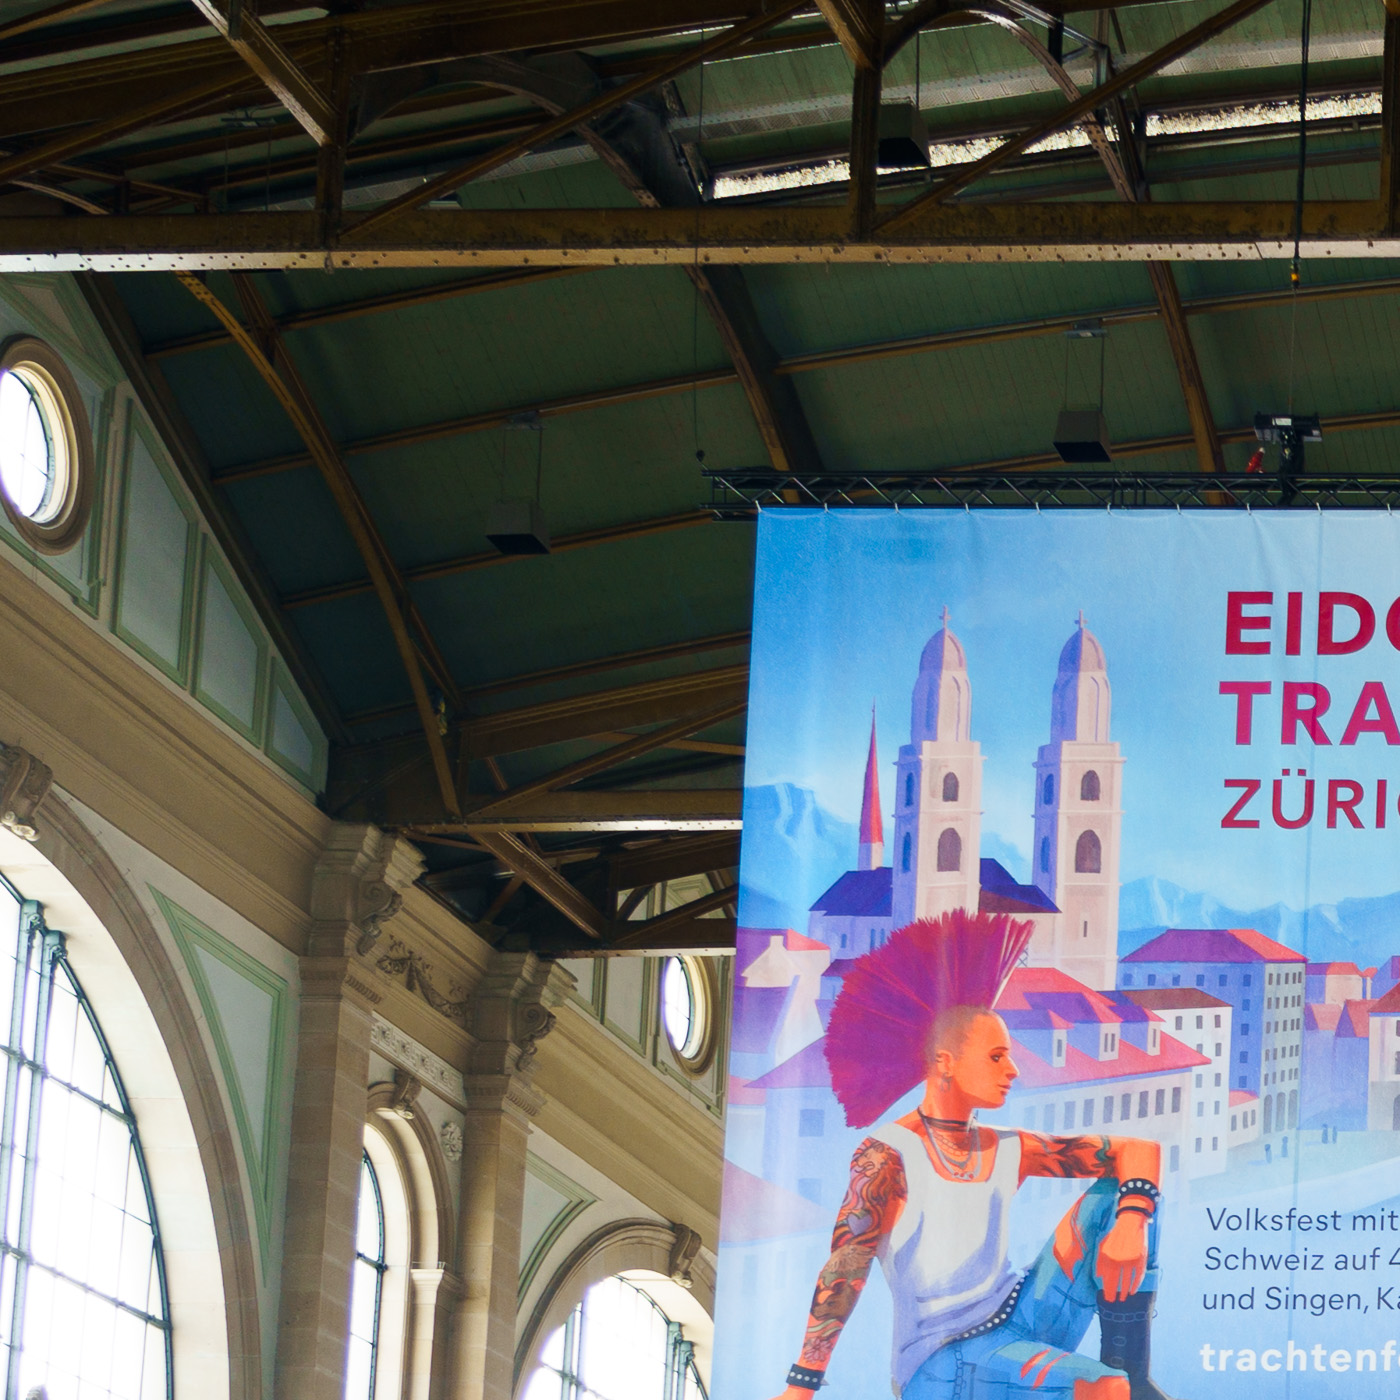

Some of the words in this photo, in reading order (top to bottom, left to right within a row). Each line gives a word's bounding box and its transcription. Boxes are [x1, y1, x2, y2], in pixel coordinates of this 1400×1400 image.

[1207, 1208, 1341, 1231] Volksfest
[1353, 1208, 1398, 1231] mit
[1205, 1247, 1323, 1270] Schweiz
[1335, 1247, 1380, 1270] auf
[1204, 1287, 1254, 1310] und
[1266, 1287, 1368, 1316] Singen,
